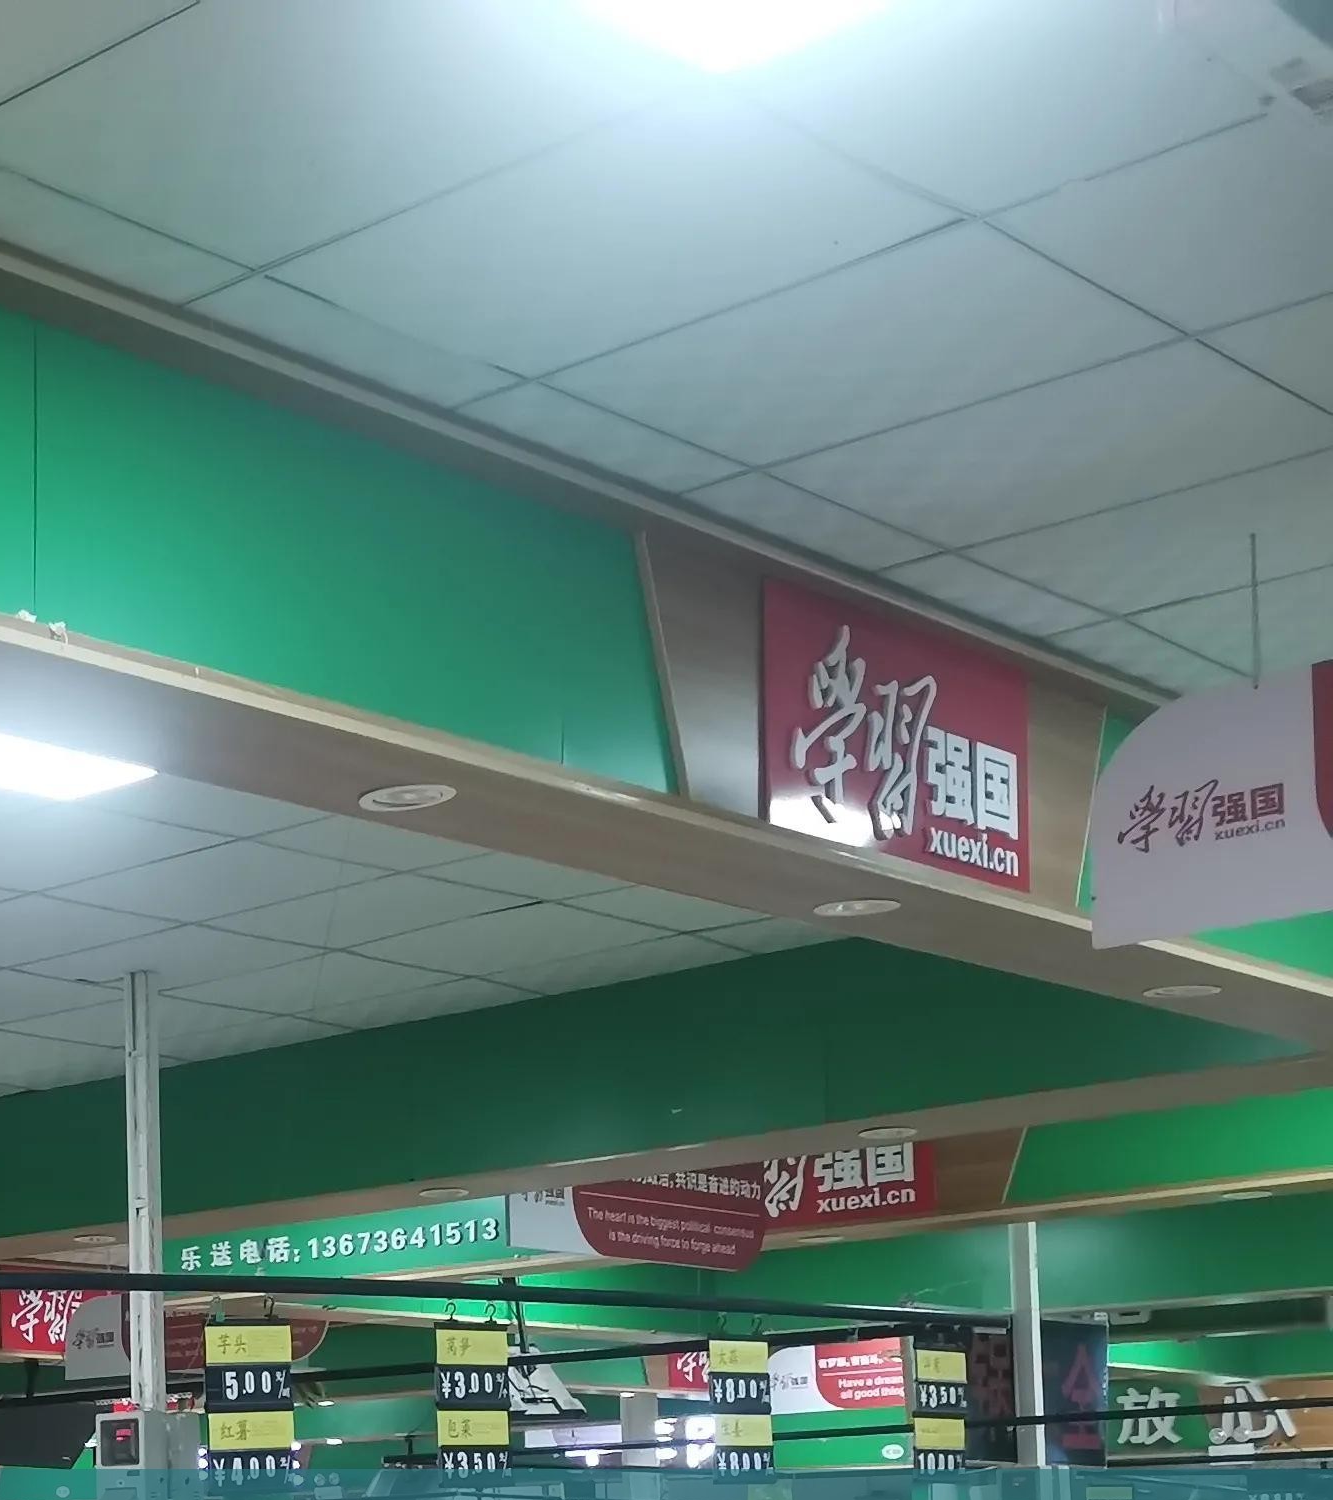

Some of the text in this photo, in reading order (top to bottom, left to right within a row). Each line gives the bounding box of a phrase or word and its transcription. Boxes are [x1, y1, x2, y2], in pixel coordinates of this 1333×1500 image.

[1214, 819, 1286, 840] xuexi.cn
[927, 827, 1020, 877] xuexi.cn
[816, 1187, 916, 1213] xuexi.cn
[307, 1217, 499, 1260] 13673641513
